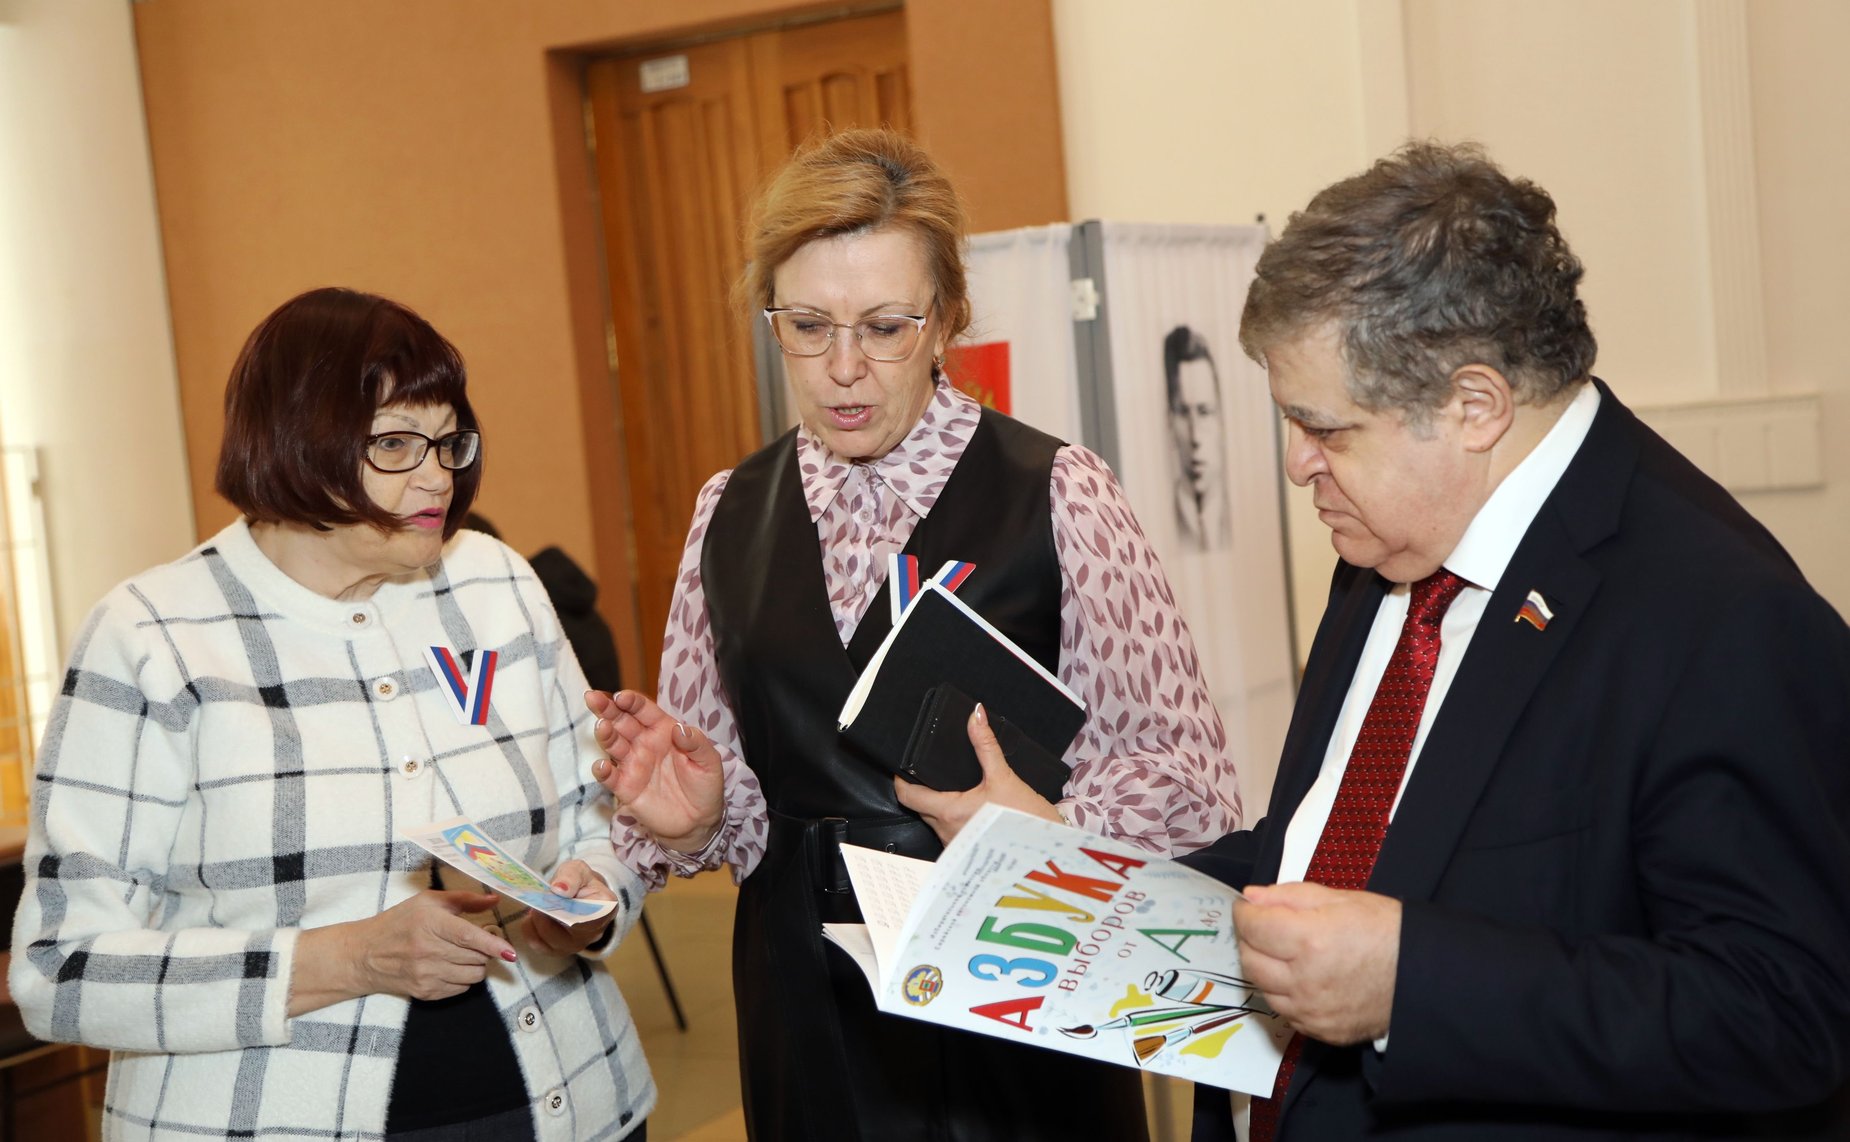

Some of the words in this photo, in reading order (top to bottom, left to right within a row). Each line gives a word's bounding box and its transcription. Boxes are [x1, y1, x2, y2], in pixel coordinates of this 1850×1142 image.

[968, 847, 1147, 1032] АЗБУКА
[1058, 891, 1146, 992] выборов
[1117, 942, 1137, 958] от
[1136, 927, 1220, 964] А
